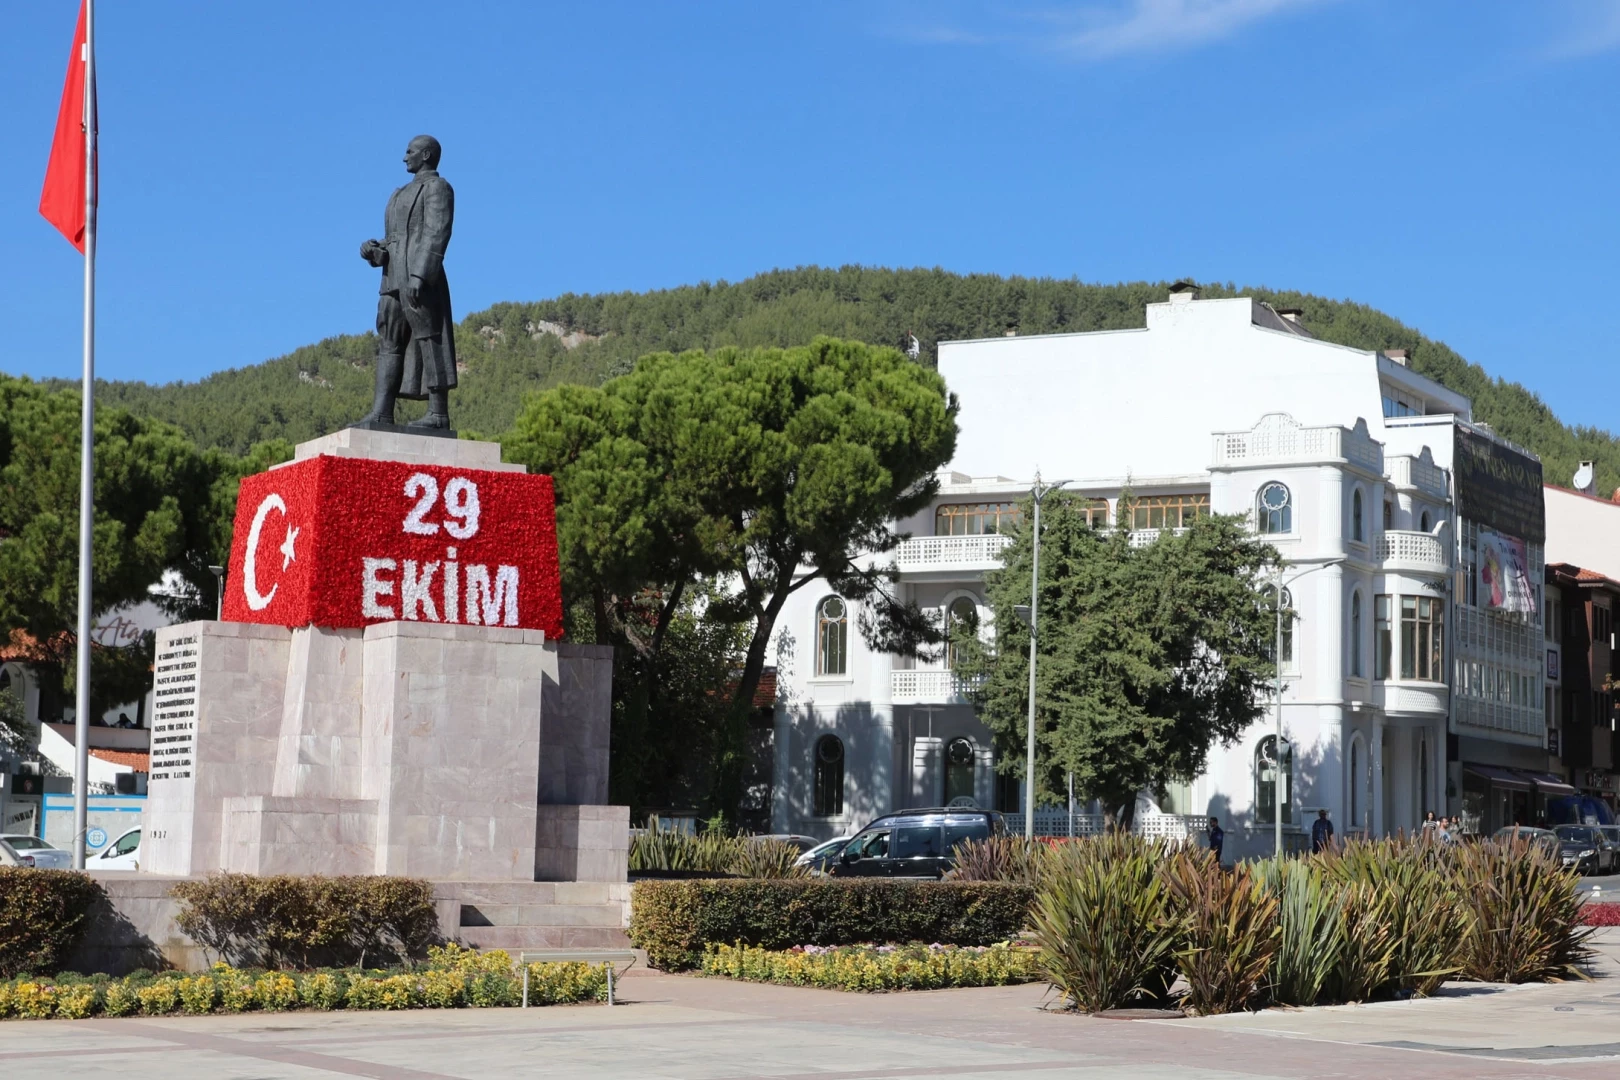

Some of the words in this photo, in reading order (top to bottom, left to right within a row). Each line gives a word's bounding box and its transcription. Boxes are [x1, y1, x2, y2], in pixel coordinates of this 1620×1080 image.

[402, 472, 481, 540] 29
[362, 546, 519, 626] EKİM
[150, 830, 167, 839] 1937
